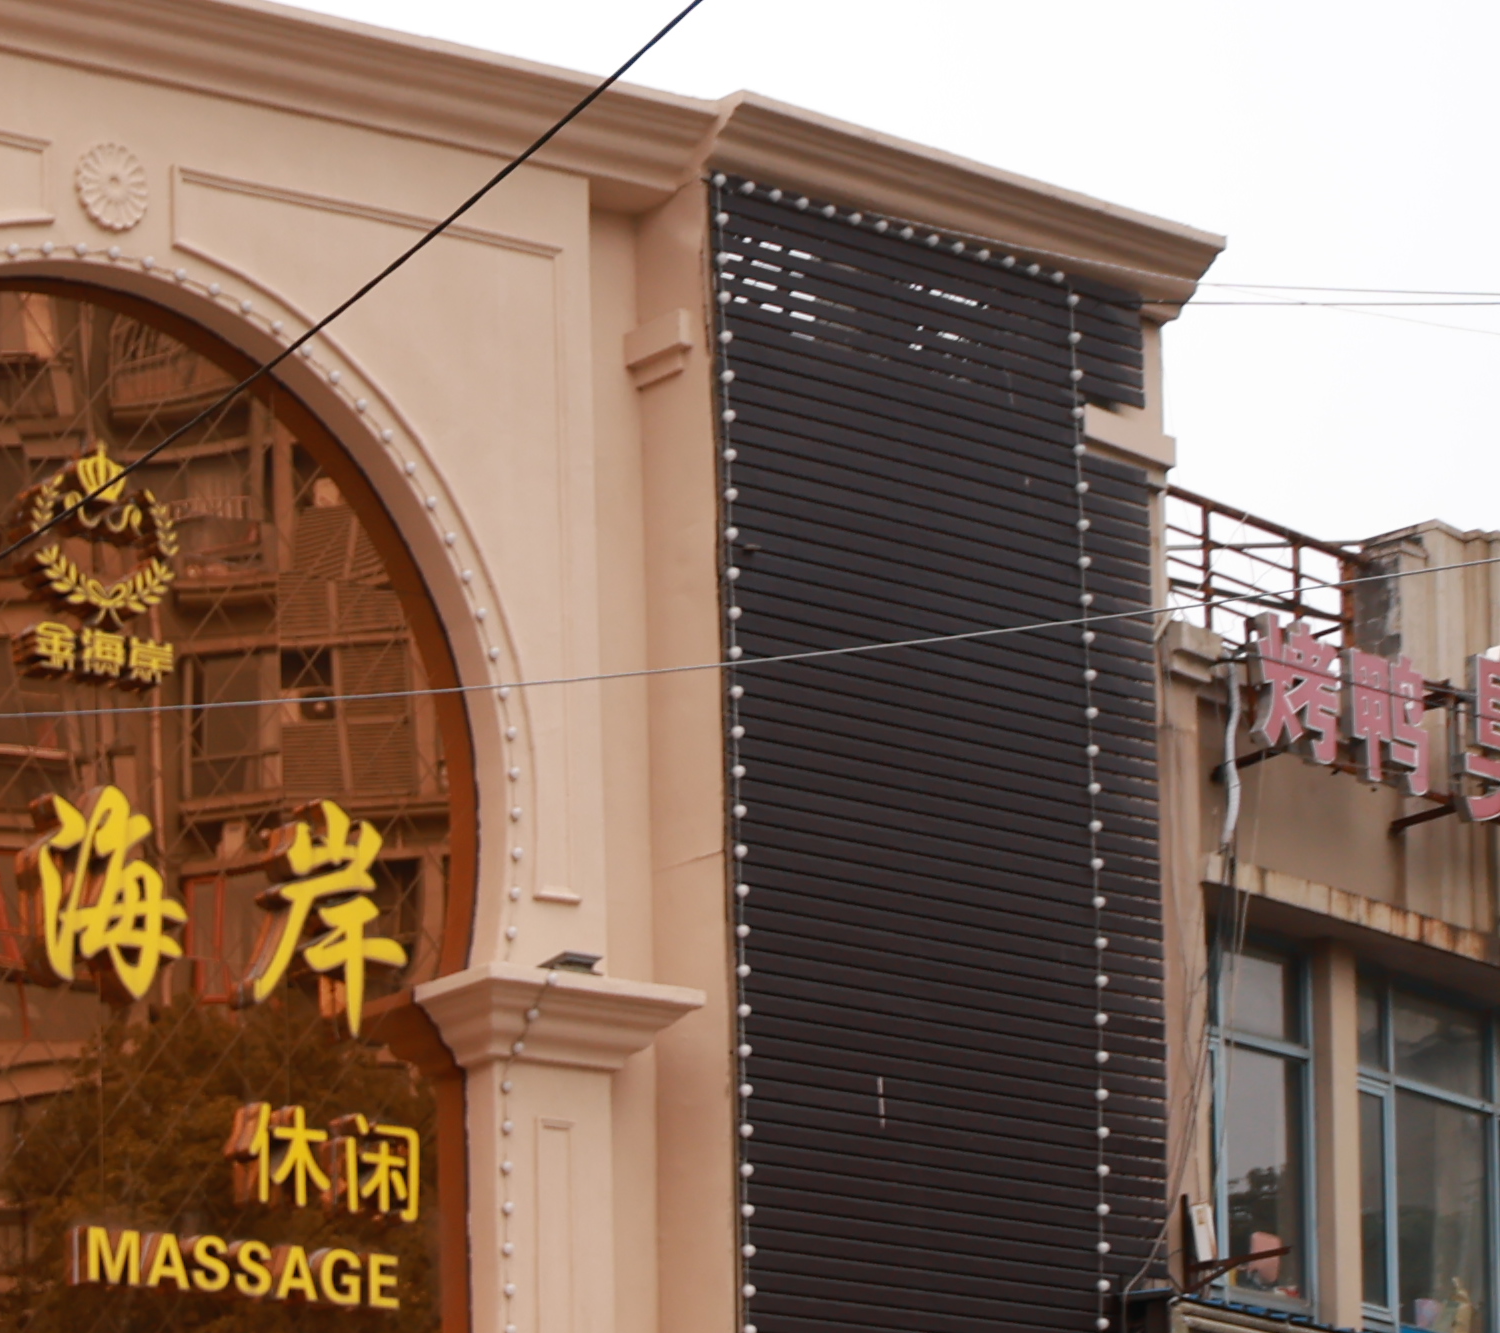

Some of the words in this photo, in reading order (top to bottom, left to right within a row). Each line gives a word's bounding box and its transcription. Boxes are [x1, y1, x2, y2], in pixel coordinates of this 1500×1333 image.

[34, 620, 175, 680] 金海岸
[247, 1100, 421, 1223] 休闲
[86, 1225, 400, 1310] MASSAGE
